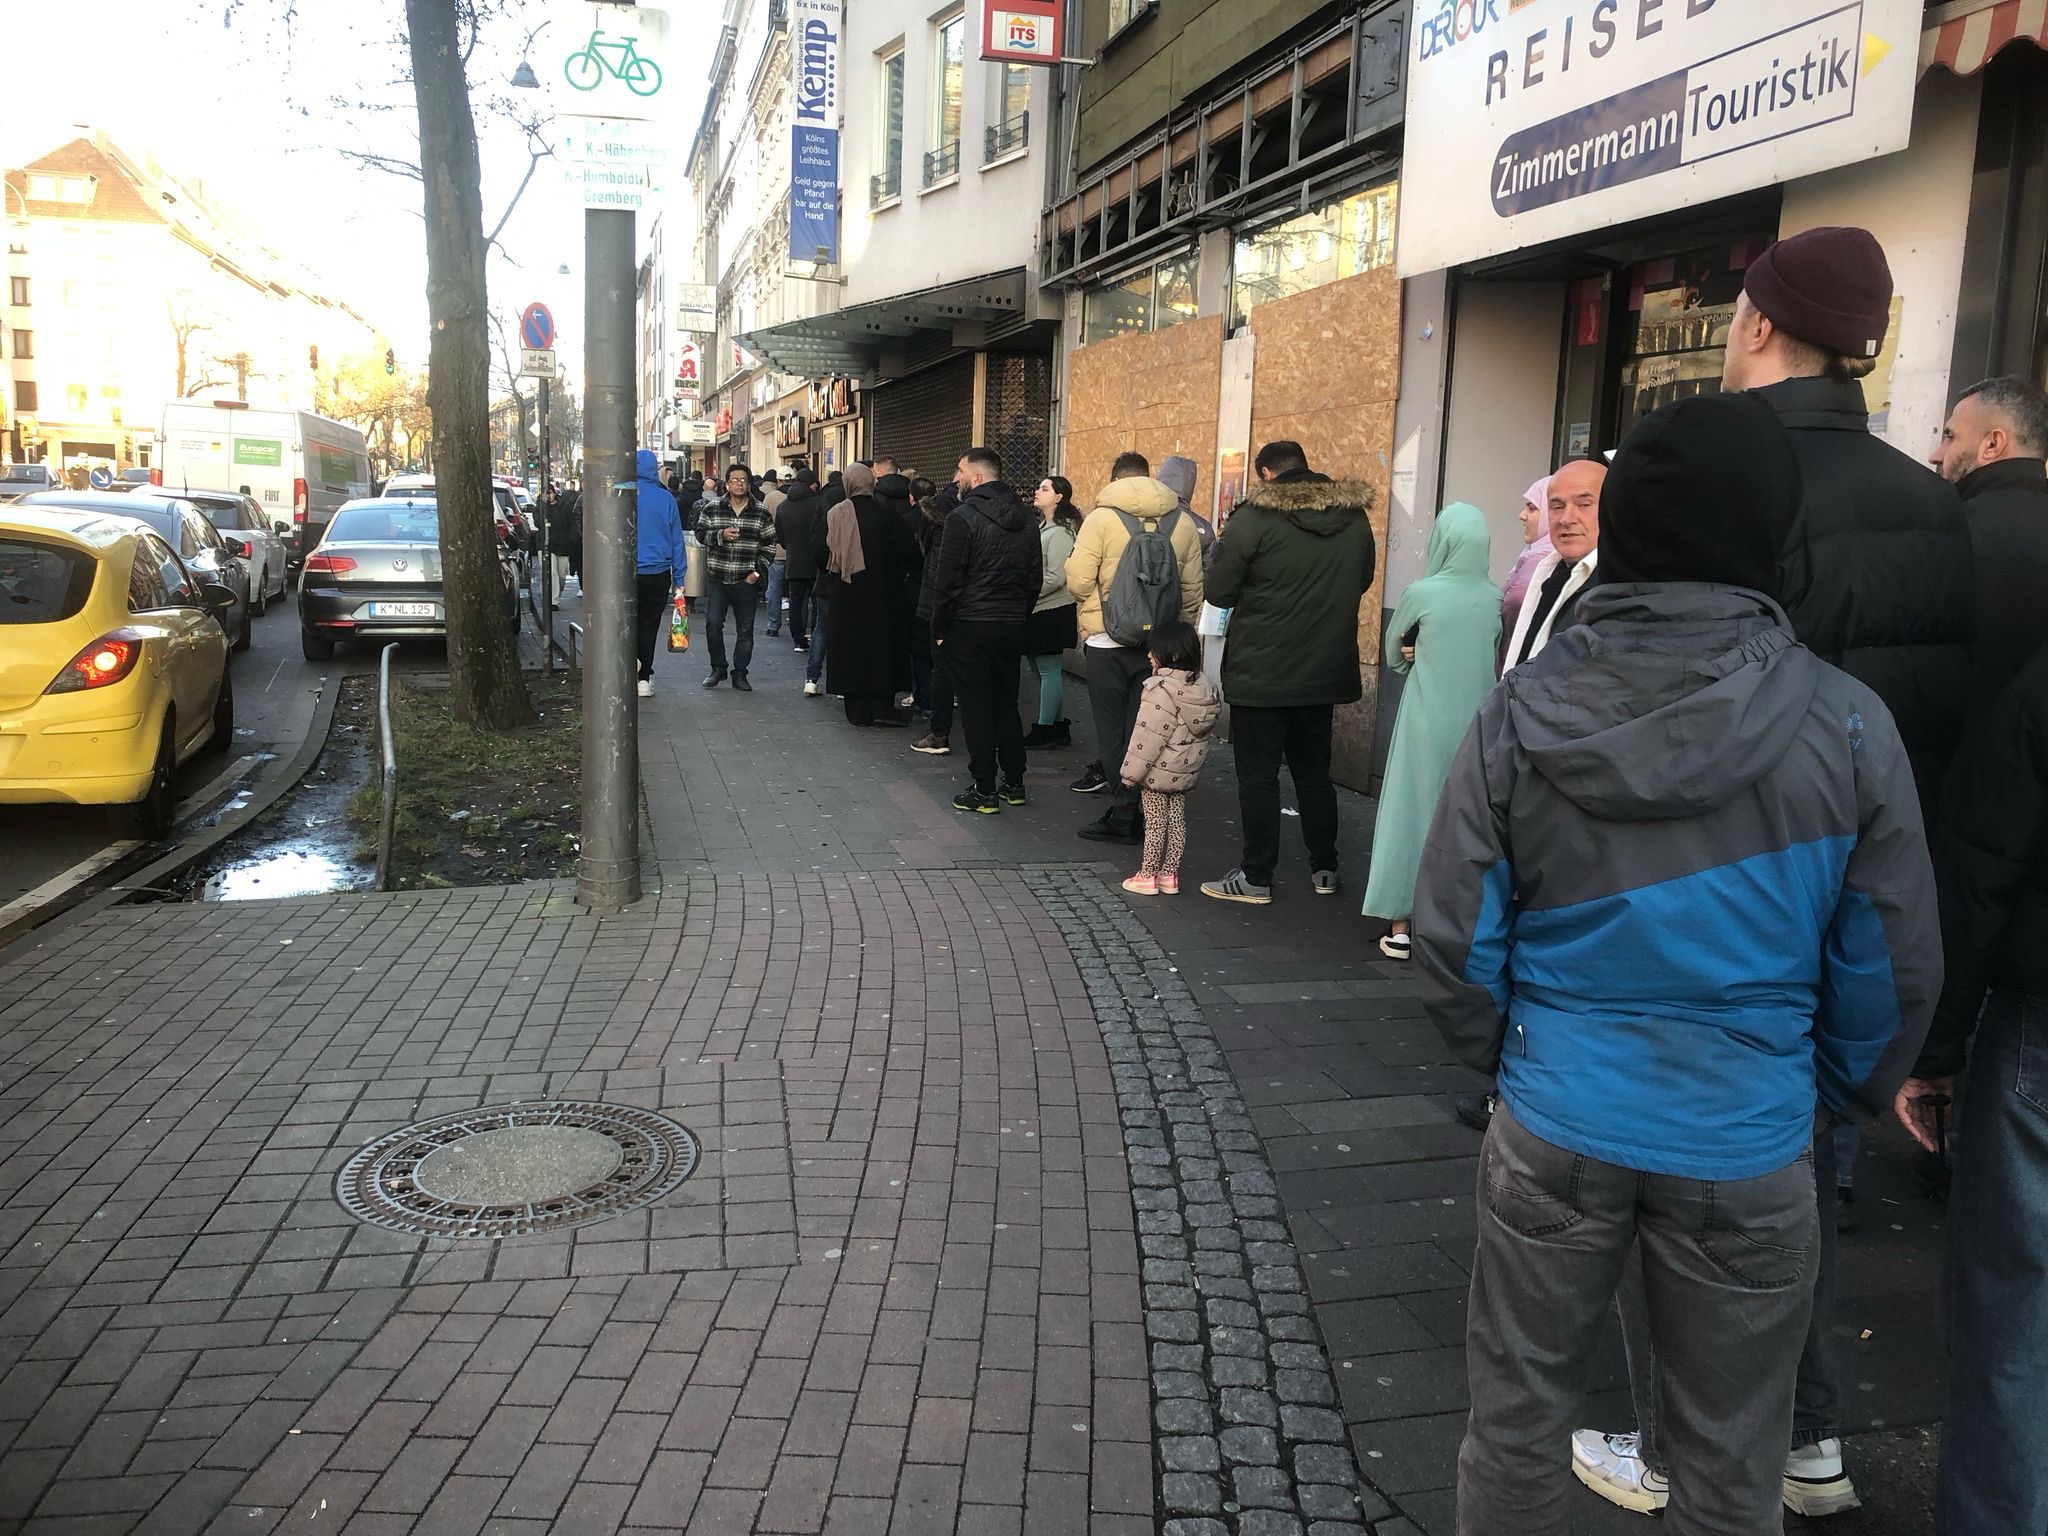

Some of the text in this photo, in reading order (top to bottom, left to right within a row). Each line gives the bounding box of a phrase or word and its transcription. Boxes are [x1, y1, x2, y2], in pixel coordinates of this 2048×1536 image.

[810, 2, 818, 10] in
[820, 3, 839, 12] Köln
[1010, 27, 1036, 41] ITS
[797, 19, 837, 122] Kemp
[1496, 36, 1852, 200] Zimmermann Touristik
[804, 133, 825, 144] Kölns
[802, 145, 829, 155] größtes
[799, 155, 832, 167] Leihhaus
[794, 176, 836, 189] Geld gegen
[804, 188, 825, 198] Pfand
[795, 199, 834, 211] bar auf die
[804, 211, 824, 221] Hand
[239, 443, 277, 453] Europcar
[264, 489, 280, 502] FIAT
[394, 604, 409, 614] NL
[411, 604, 430, 614] 125
